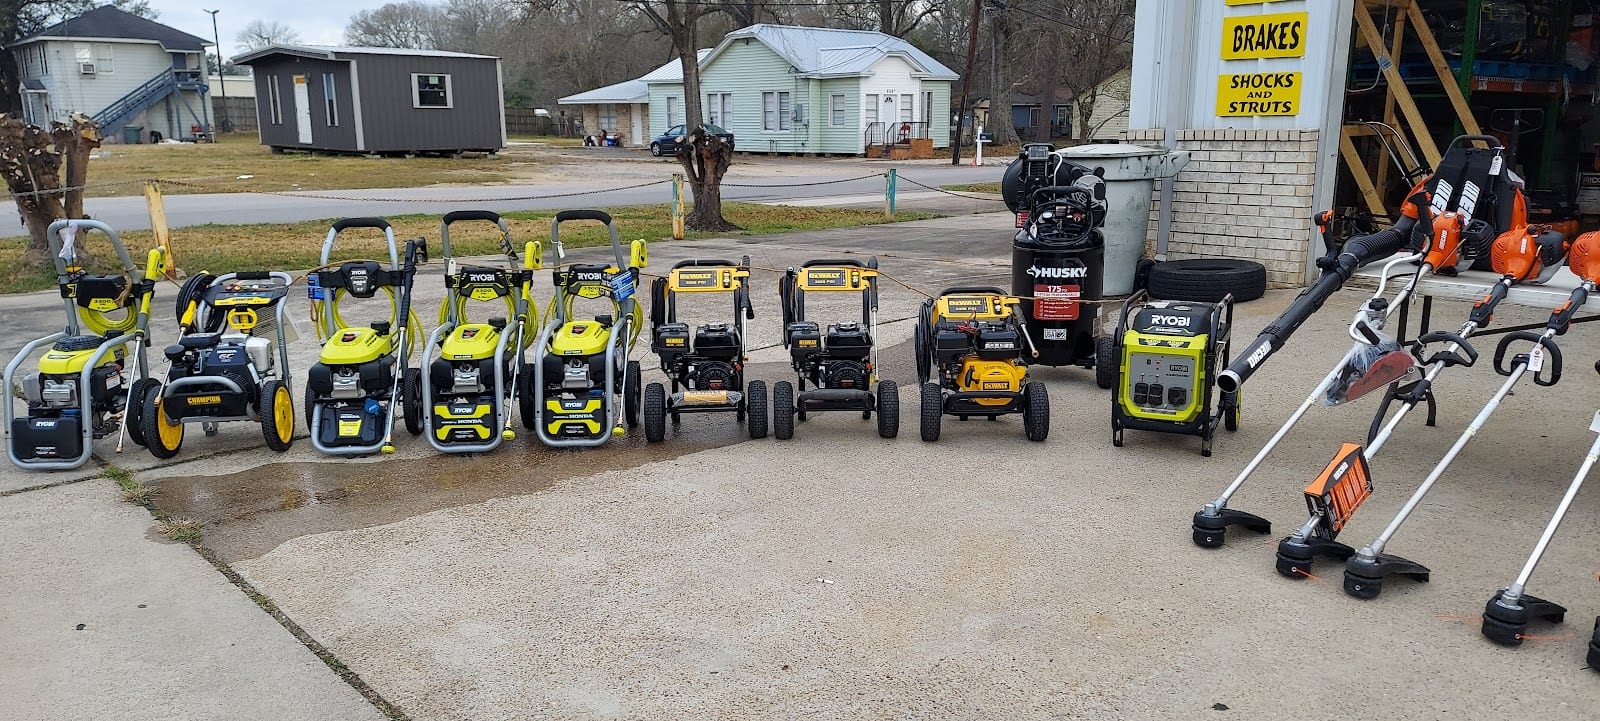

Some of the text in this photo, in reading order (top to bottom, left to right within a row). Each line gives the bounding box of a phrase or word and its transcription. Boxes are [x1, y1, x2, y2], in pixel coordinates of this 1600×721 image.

[1232, 21, 1300, 52] BRAKES
[1230, 74, 1294, 88] SHOCKS
[1228, 101, 1292, 113] STRUTS
[469, 273, 495, 281] RYOBI
[577, 272, 602, 280] RYOBI
[1041, 266, 1087, 278] HUSKY
[1151, 314, 1191, 327] RYOBI
[1247, 340, 1272, 369] ECHO
[983, 382, 1009, 390] DEWALT
[187, 396, 221, 405] CHAMPION
